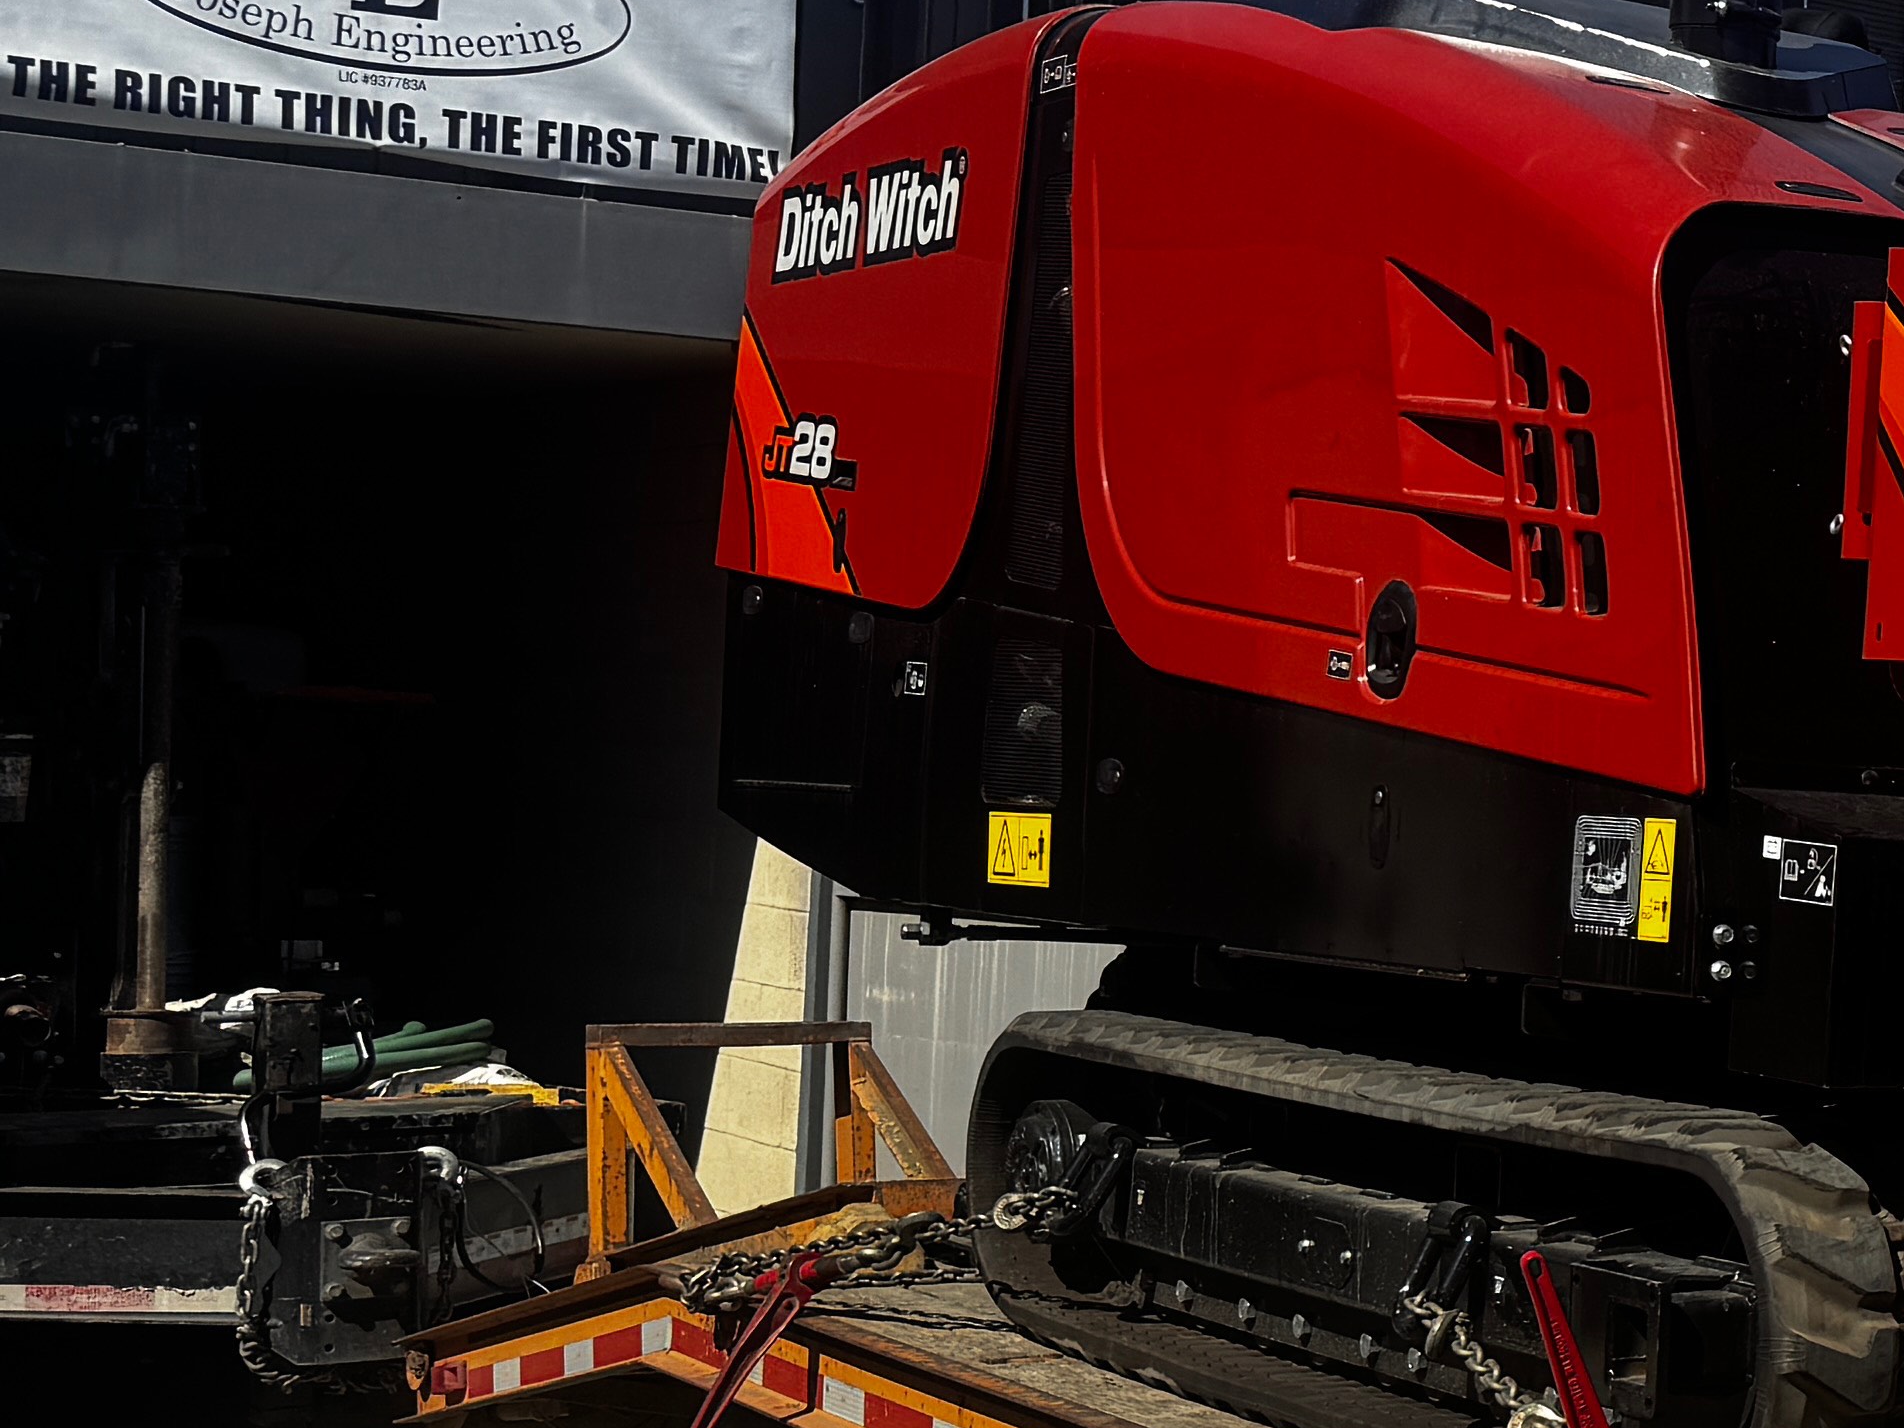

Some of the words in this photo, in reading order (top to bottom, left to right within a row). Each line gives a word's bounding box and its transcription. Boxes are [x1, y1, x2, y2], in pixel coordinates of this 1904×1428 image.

[330, 12, 583, 63] Engineering
[6, 54, 98, 107] THE
[113, 68, 261, 126] RIGHT
[274, 88, 428, 149] THING,
[441, 108, 524, 156] THE
[536, 119, 660, 171] FIRST
[775, 184, 859, 274] Ditch
[865, 159, 960, 256] Witch
